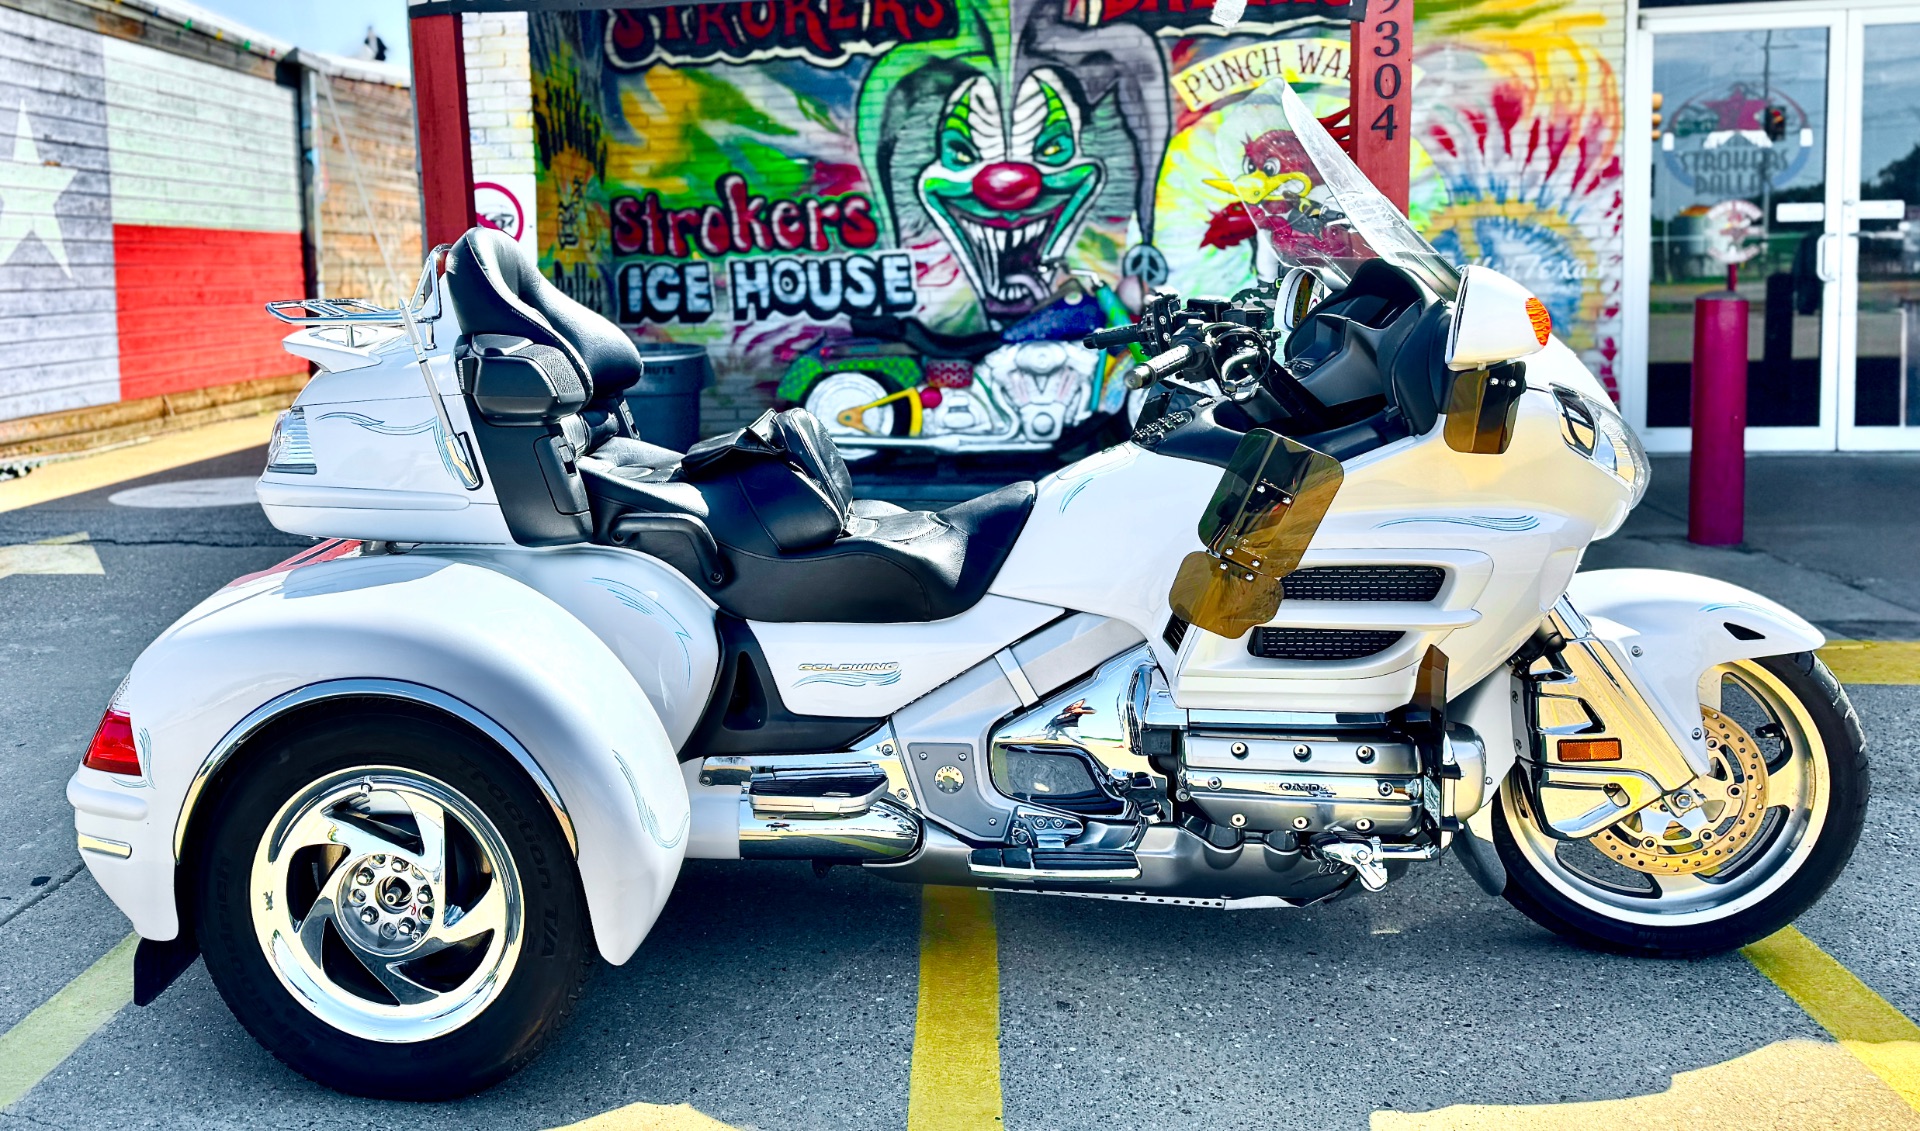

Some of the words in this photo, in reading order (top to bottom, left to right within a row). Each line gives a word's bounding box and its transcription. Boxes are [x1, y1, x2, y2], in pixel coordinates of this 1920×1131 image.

[1181, 45, 1283, 105] PUNCH
[612, 173, 879, 256] Strokers
[617, 260, 712, 322] ICE
[730, 252, 917, 322] HOUSE
[797, 661, 900, 672] GOLDWING
